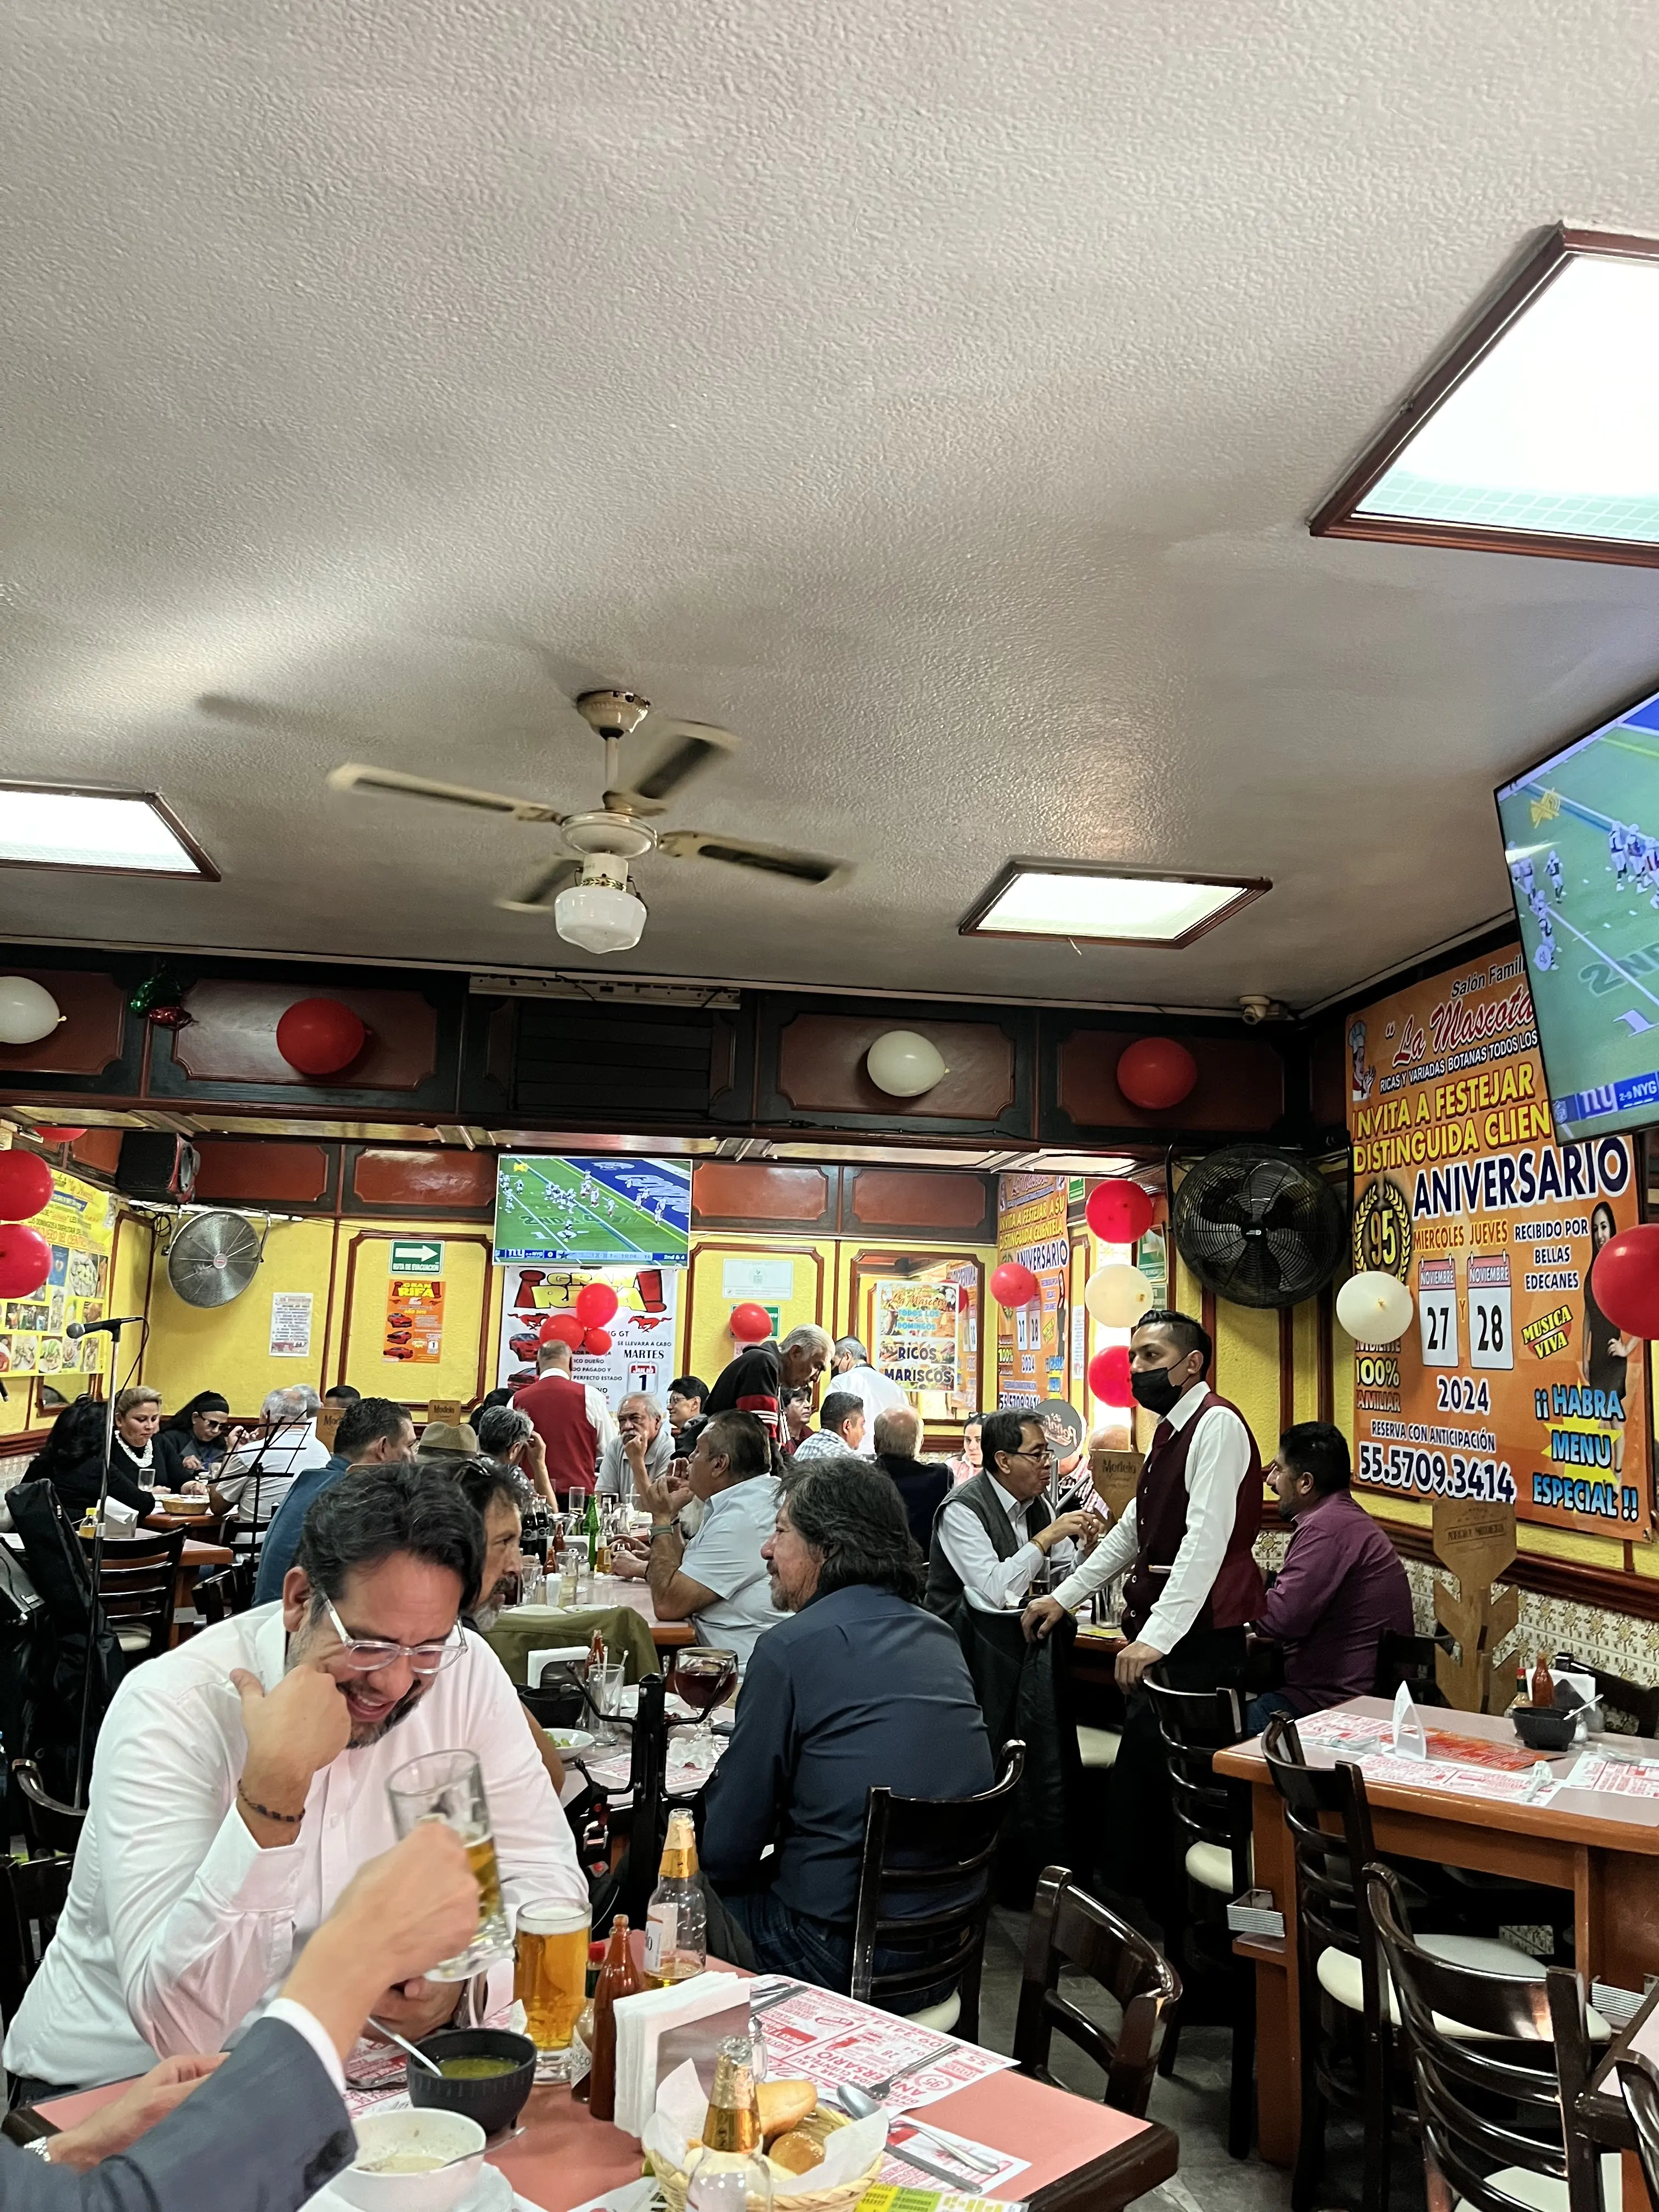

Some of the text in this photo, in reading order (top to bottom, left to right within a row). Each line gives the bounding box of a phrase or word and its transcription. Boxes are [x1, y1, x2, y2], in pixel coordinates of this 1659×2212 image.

[1452, 954, 1525, 998] Salón Famil
[1379, 1029, 1538, 1094] RICAS Y VARIADAS BOTANAS TODOS LOS
[1352, 1061, 1536, 1141] INVITA A FESTEJAR
[1633, 1079, 1657, 1098] NYG
[1352, 1099, 1553, 1177] DISTINGUIDA CLIEN
[1412, 1135, 1630, 1221] ANIVERSARIO
[1023, 1200, 1048, 1226] FESTEJAR
[1055, 1195, 1065, 1215] SU
[1371, 1209, 1397, 1265] 95
[1413, 1216, 1590, 1253] MIERCOLES JUEVES RECIBIDO POR
[1533, 1244, 1572, 1266] BELLAS
[398, 1287, 435, 1298] RIFA
[1420, 1265, 1581, 1292] NOVIEMBRE NOVIEMBRE EDECANES
[897, 1322, 937, 1330] DOMINGOS
[898, 1308, 923, 1317] TODOS
[1427, 1297, 1504, 1352] 27 Y 28
[1521, 1304, 1573, 1345] MUSICA
[623, 1349, 664, 1359] MARTES
[898, 1346, 938, 1361] RICOS
[1533, 1330, 1568, 1359] VIVA
[639, 1374, 647, 1391] 1
[884, 1368, 952, 1384] MARISCOS
[1356, 1357, 1400, 1387] 100%
[433, 1404, 455, 1414] Modelo
[1436, 1374, 1491, 1415] 2024
[1551, 1383, 1627, 1422] HABRA
[1370, 1419, 1497, 1454] RESERVA CON ANTICIPACIÓN
[1550, 1429, 1612, 1469] MENU
[1102, 1459, 1136, 1474] Modelo
[1359, 1441, 1517, 1505] 55.5709.3414
[1532, 1471, 1619, 1519] ESPECIAL
[923, 2077, 945, 2089] 95
